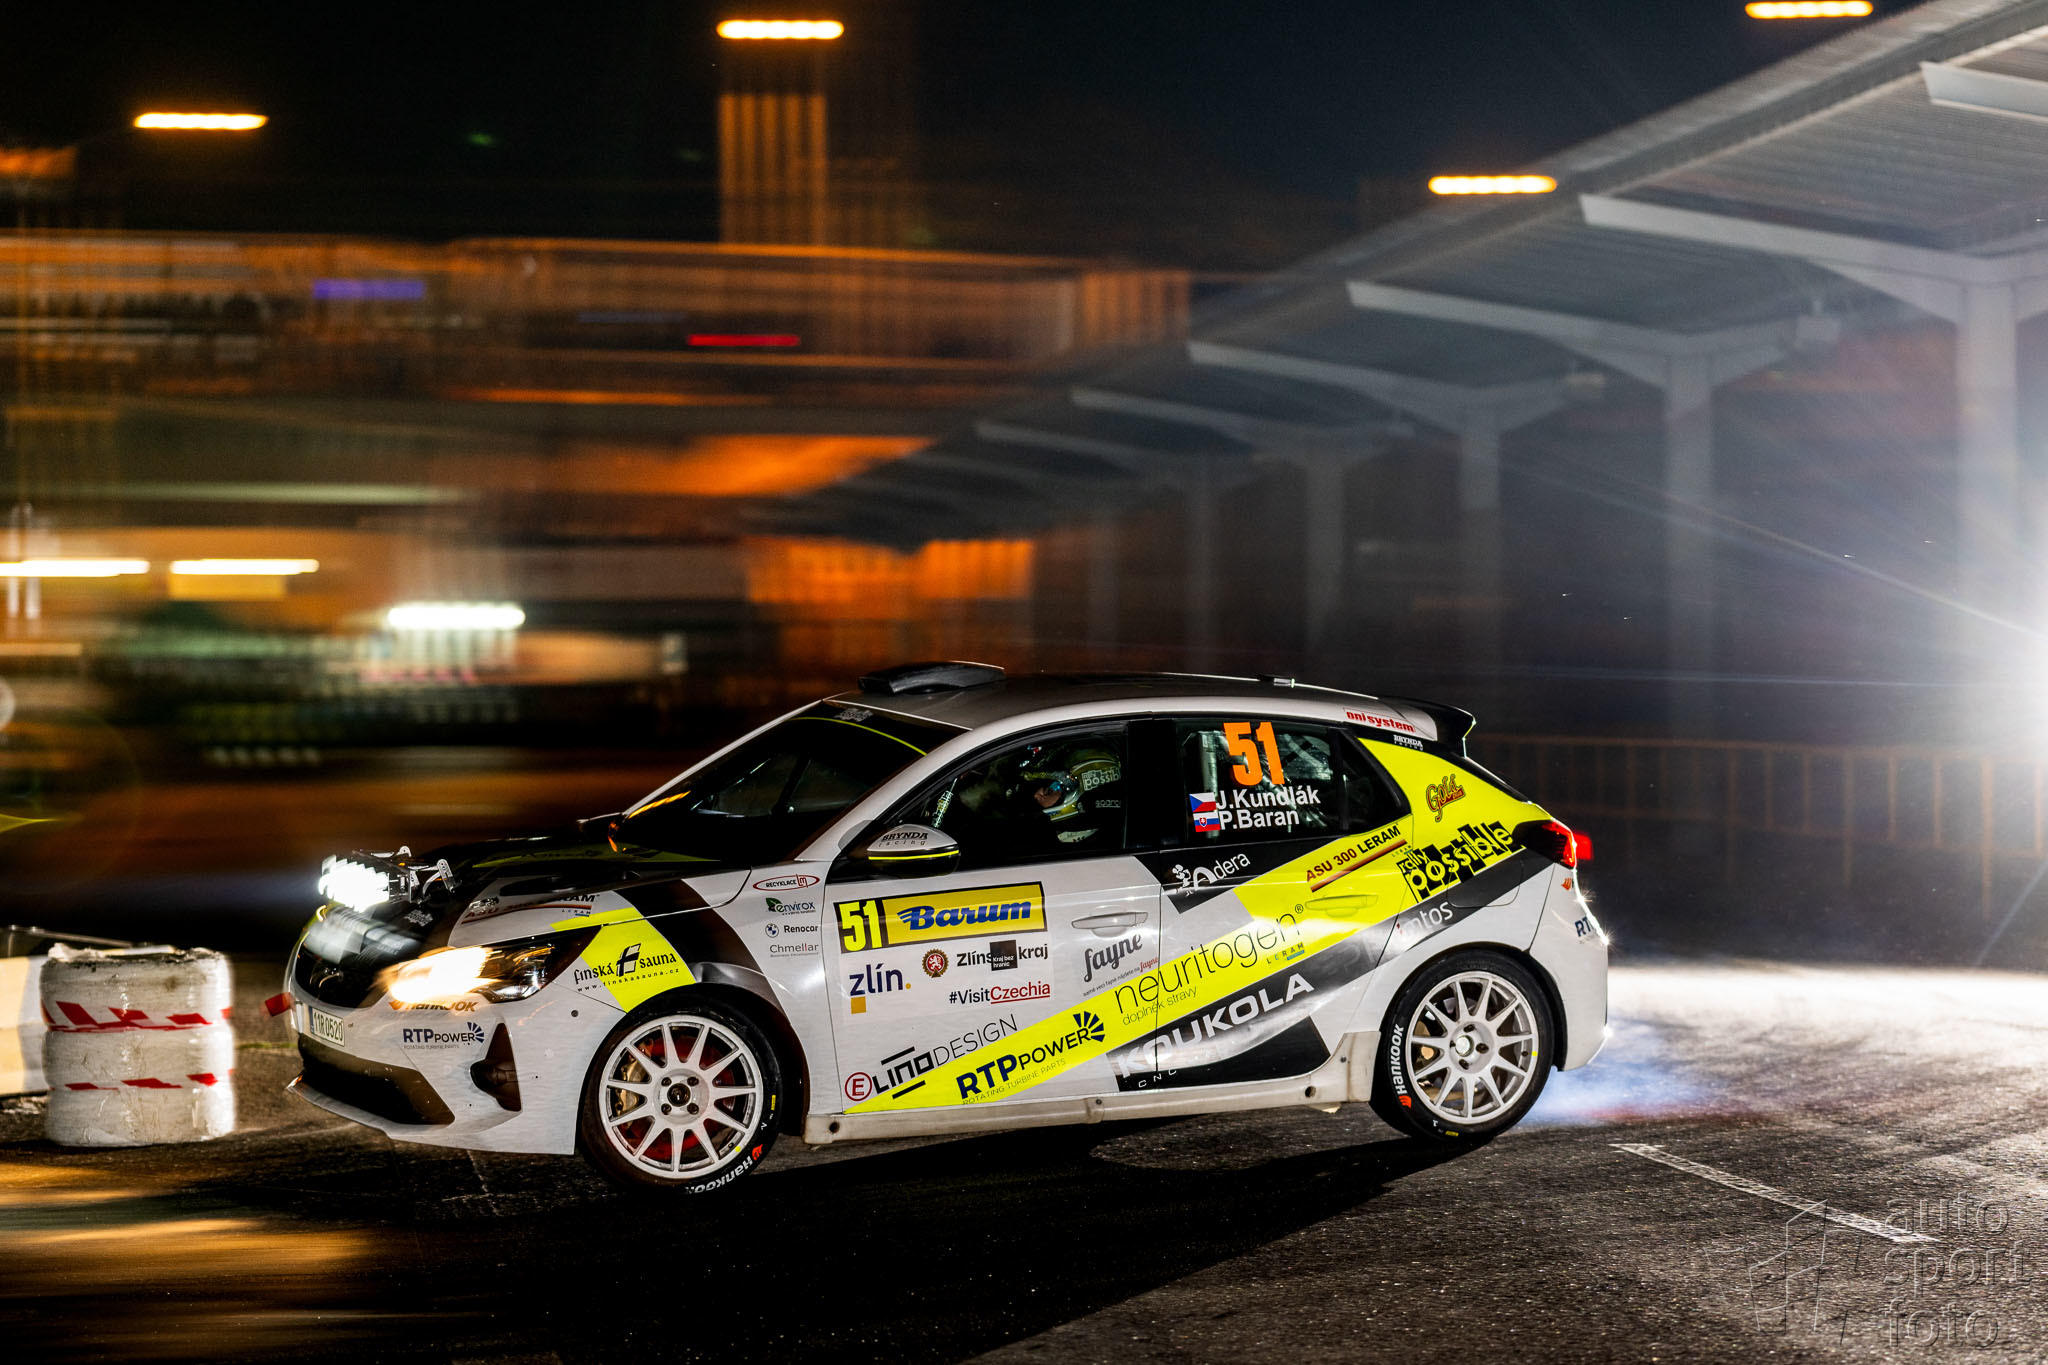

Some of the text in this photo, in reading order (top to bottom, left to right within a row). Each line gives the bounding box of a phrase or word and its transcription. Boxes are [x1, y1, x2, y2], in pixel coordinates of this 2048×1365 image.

[1223, 721, 1285, 786] 51
[1216, 785, 1321, 811] J.Kundlák
[1426, 774, 1457, 822] Gold
[1218, 810, 1300, 830] P.Baran
[881, 831, 929, 842] BRYNDA
[1306, 825, 1401, 882] ASU 300 LERAM
[1398, 850, 1431, 874] rally
[1405, 826, 1514, 901] possible
[766, 880, 797, 889] RECYKLACE
[1192, 853, 1251, 891] Adera
[776, 901, 816, 913] envirox
[897, 901, 1032, 931] Barum
[784, 925, 818, 933] Renocar
[838, 900, 883, 952] 51
[769, 943, 819, 953] Chmellar
[1018, 943, 1049, 960] kraj
[1084, 933, 1143, 982] fayne
[574, 962, 614, 985] finská
[639, 953, 677, 969] sauna
[577, 968, 680, 992] www.finskasauna.cz
[949, 981, 1050, 1004] #VisitCzechia
[1123, 985, 1198, 1026] doplněk stravy
[1115, 972, 1315, 1079] KOUKOLA
[1006, 1072, 1039, 1089] TURBINE
[1040, 1057, 1066, 1074] PARTS
